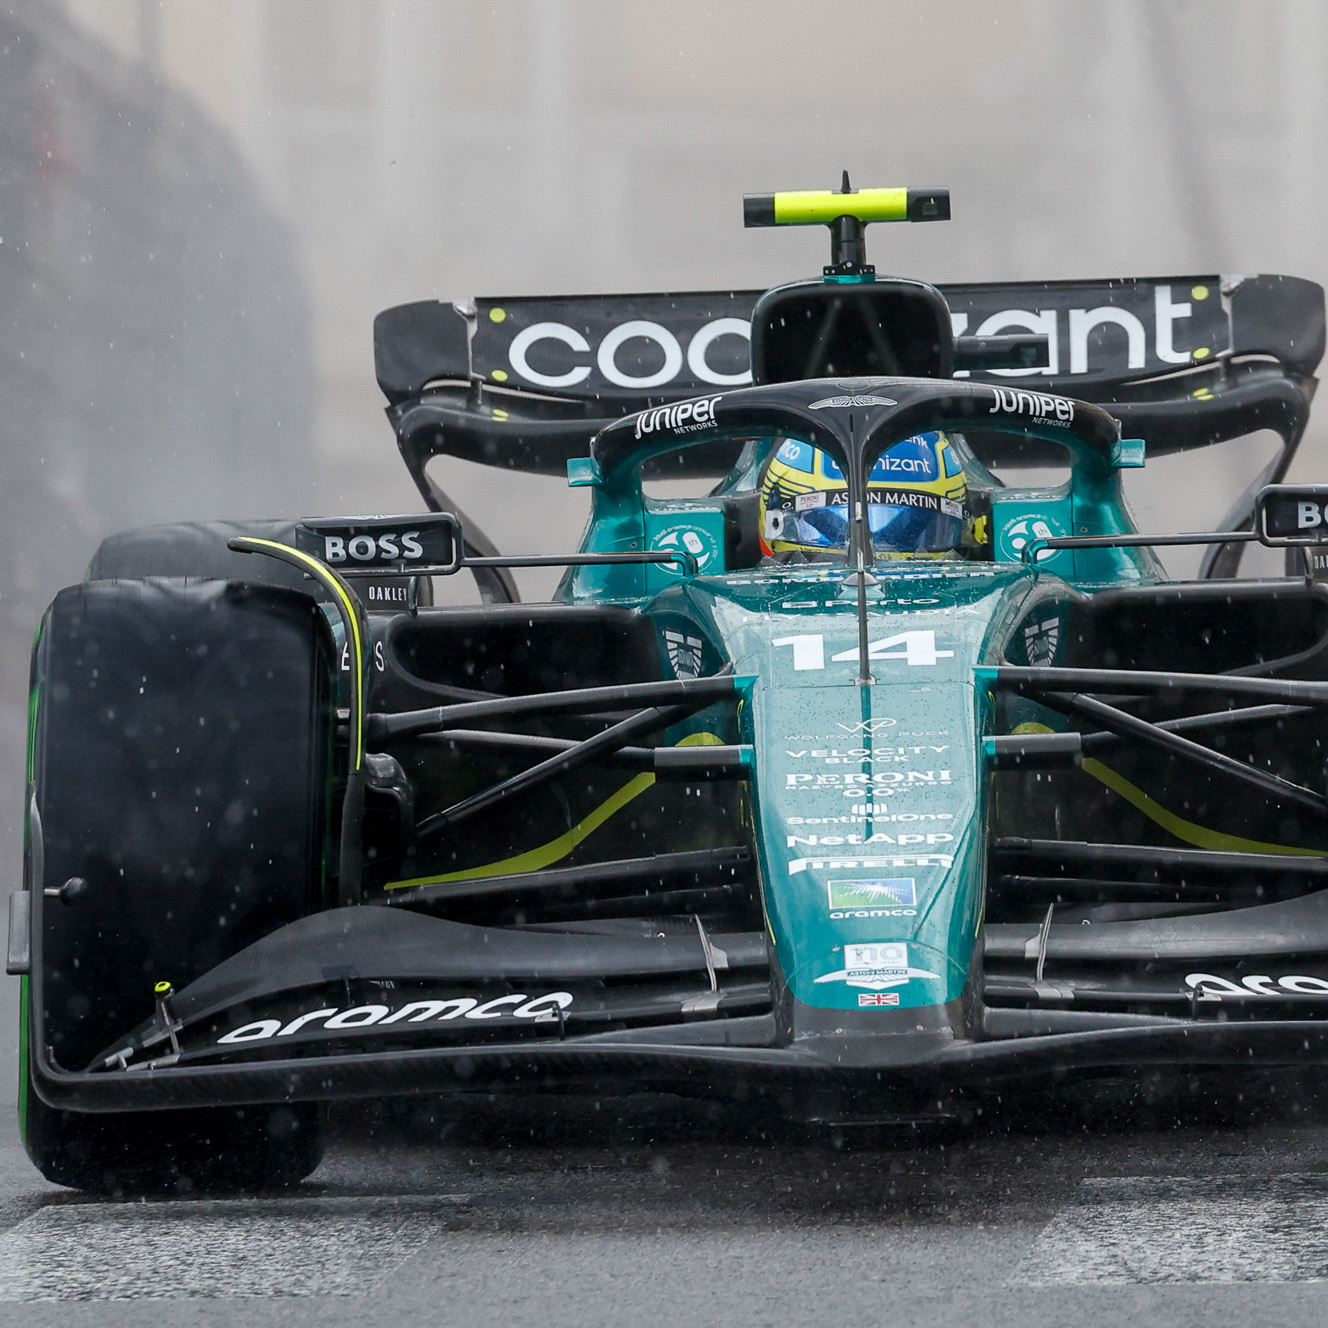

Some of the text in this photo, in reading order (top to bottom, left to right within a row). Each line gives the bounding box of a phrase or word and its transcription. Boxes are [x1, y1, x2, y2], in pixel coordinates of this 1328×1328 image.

[509, 285, 1194, 386] coant
[673, 420, 718, 435] NETWORKS
[1031, 417, 1072, 429] NETWORKS
[832, 455, 931, 474] nizant
[831, 491, 881, 504] ASN
[885, 492, 938, 510] MARTIN
[324, 531, 423, 563] BOSS
[771, 629, 955, 671] 14
[784, 732, 889, 741] WOLFGANG
[784, 745, 950, 758] VELOCITY
[824, 755, 909, 764] BLACK
[785, 770, 952, 786] PERONI
[786, 813, 954, 825] SentinelOne
[786, 832, 954, 848] NetApp
[788, 854, 954, 876] PIRELLI
[829, 909, 918, 919] aramco
[217, 991, 574, 1045] aramco
